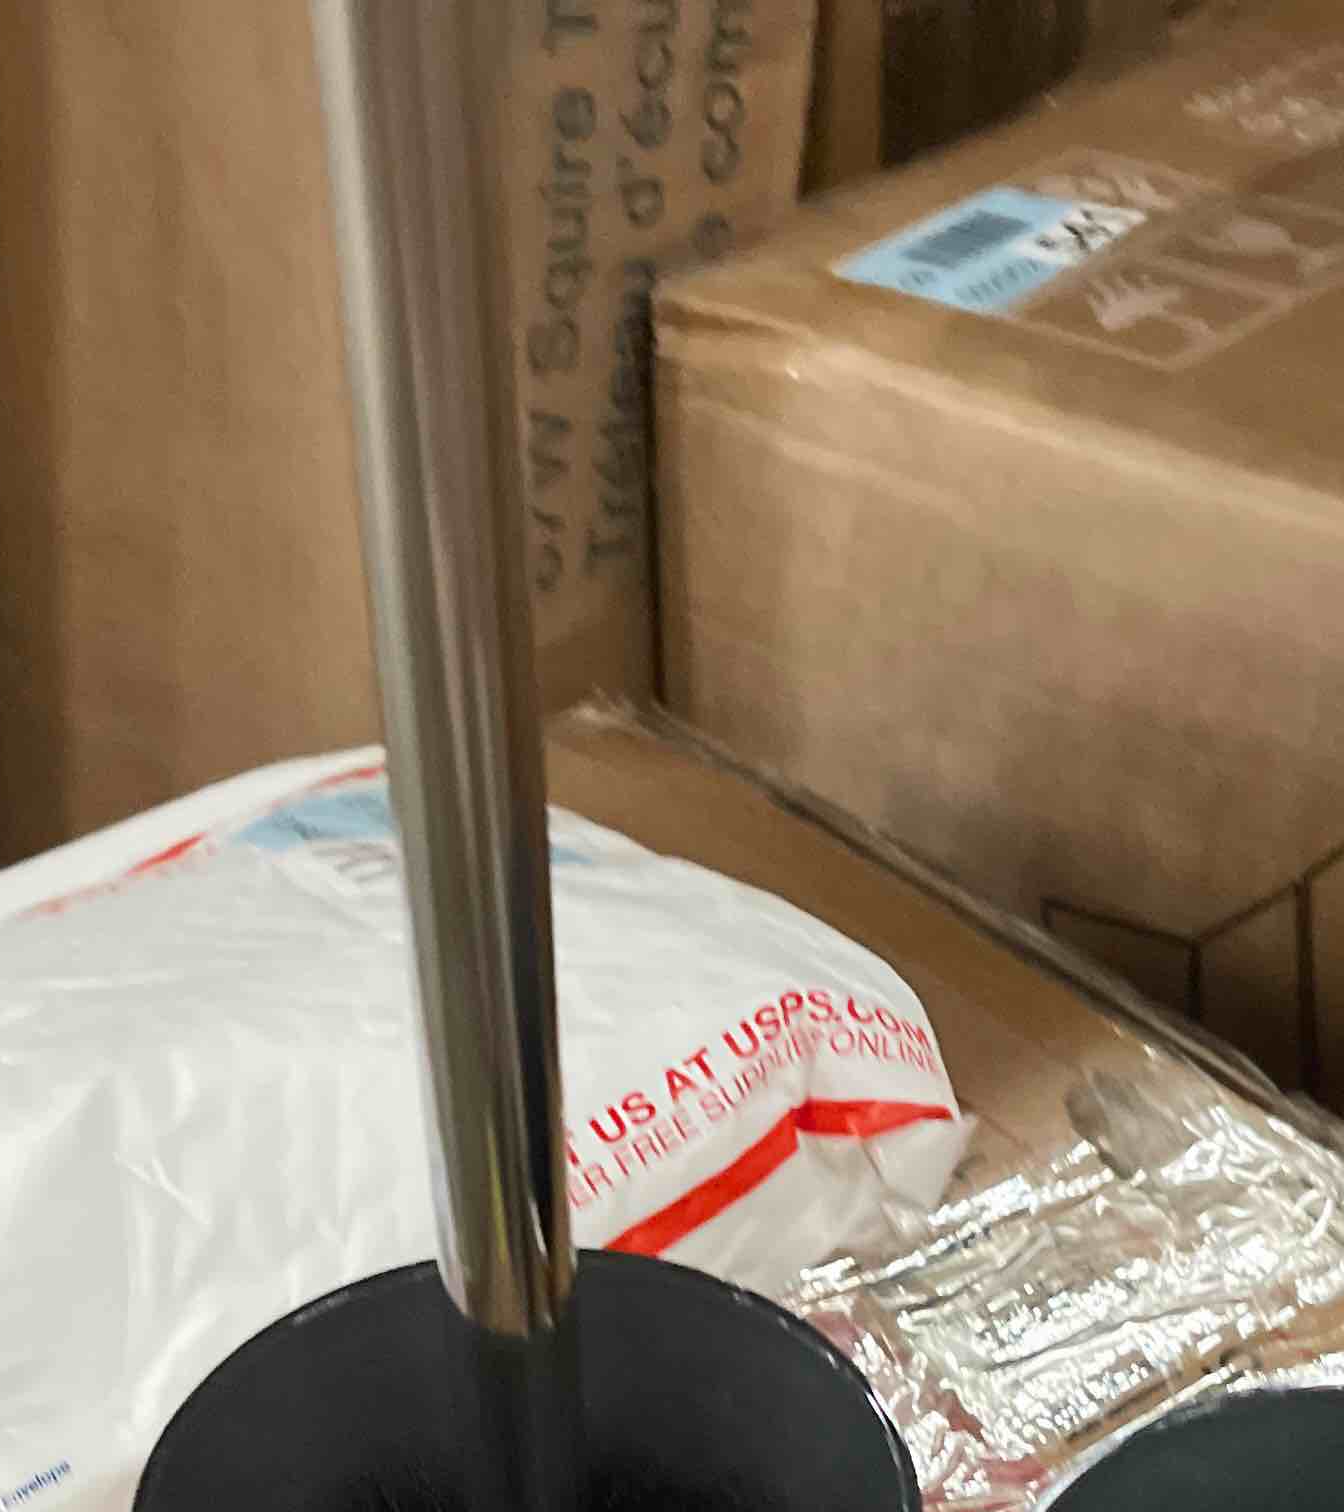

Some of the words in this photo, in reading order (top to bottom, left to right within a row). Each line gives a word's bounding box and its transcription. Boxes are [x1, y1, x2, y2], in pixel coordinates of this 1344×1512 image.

[526, 86, 597, 379] Squire
[584, 1085, 661, 1149] US
[658, 1046, 715, 1104] AT
[721, 987, 932, 1058] USPS.COM
[611, 1106, 698, 1178] FREE
[825, 1025, 938, 1073] ONLINE
